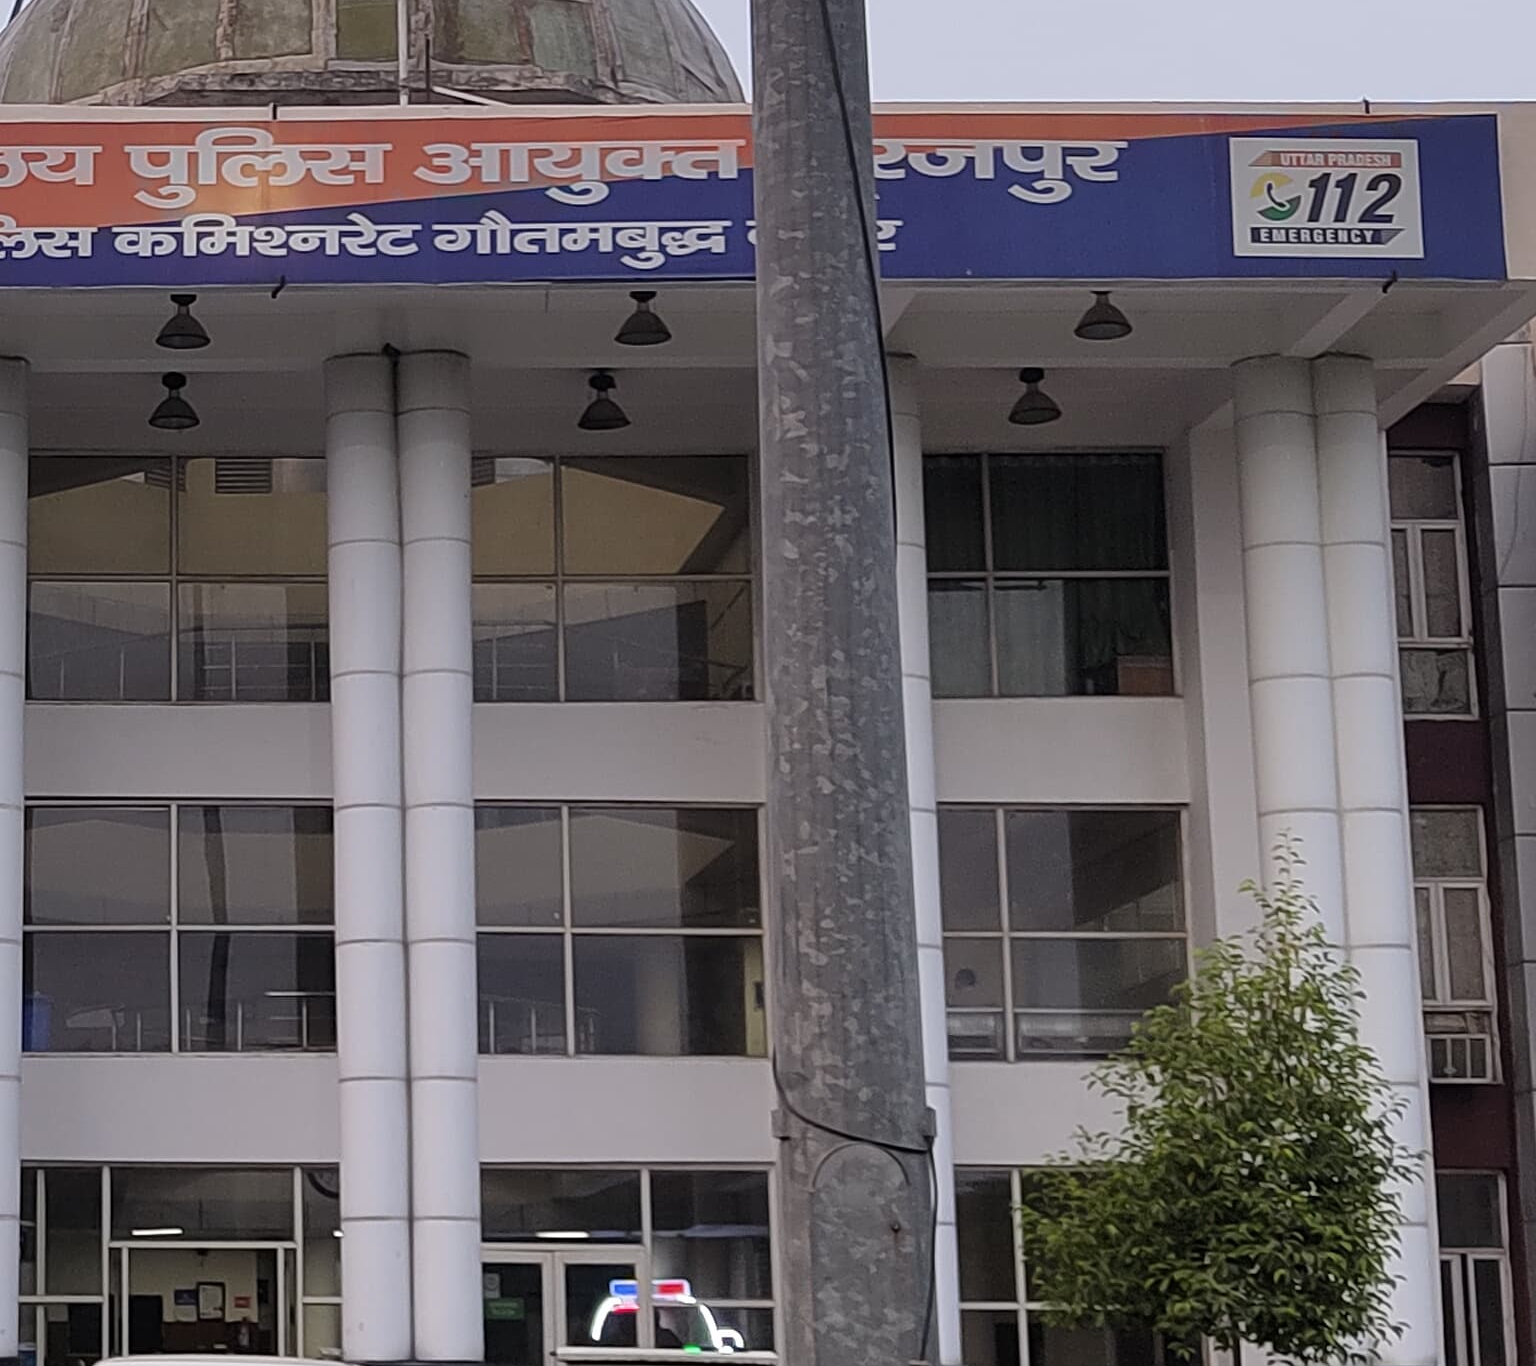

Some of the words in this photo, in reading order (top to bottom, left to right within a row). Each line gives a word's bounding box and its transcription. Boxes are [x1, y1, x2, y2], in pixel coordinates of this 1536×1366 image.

[123, 126, 393, 210] पुलिस
[413, 138, 747, 206] आयुक्त
[873, 138, 1129, 203] रजपुर
[1280, 152, 1325, 167] UTTAR
[1327, 153, 1392, 167] PRADESH
[1306, 172, 1403, 224] 112
[111, 212, 423, 257] कमिश्नरेट
[431, 209, 733, 270] गौतमबुद्ध
[1259, 228, 1374, 244] EMERGENCY
